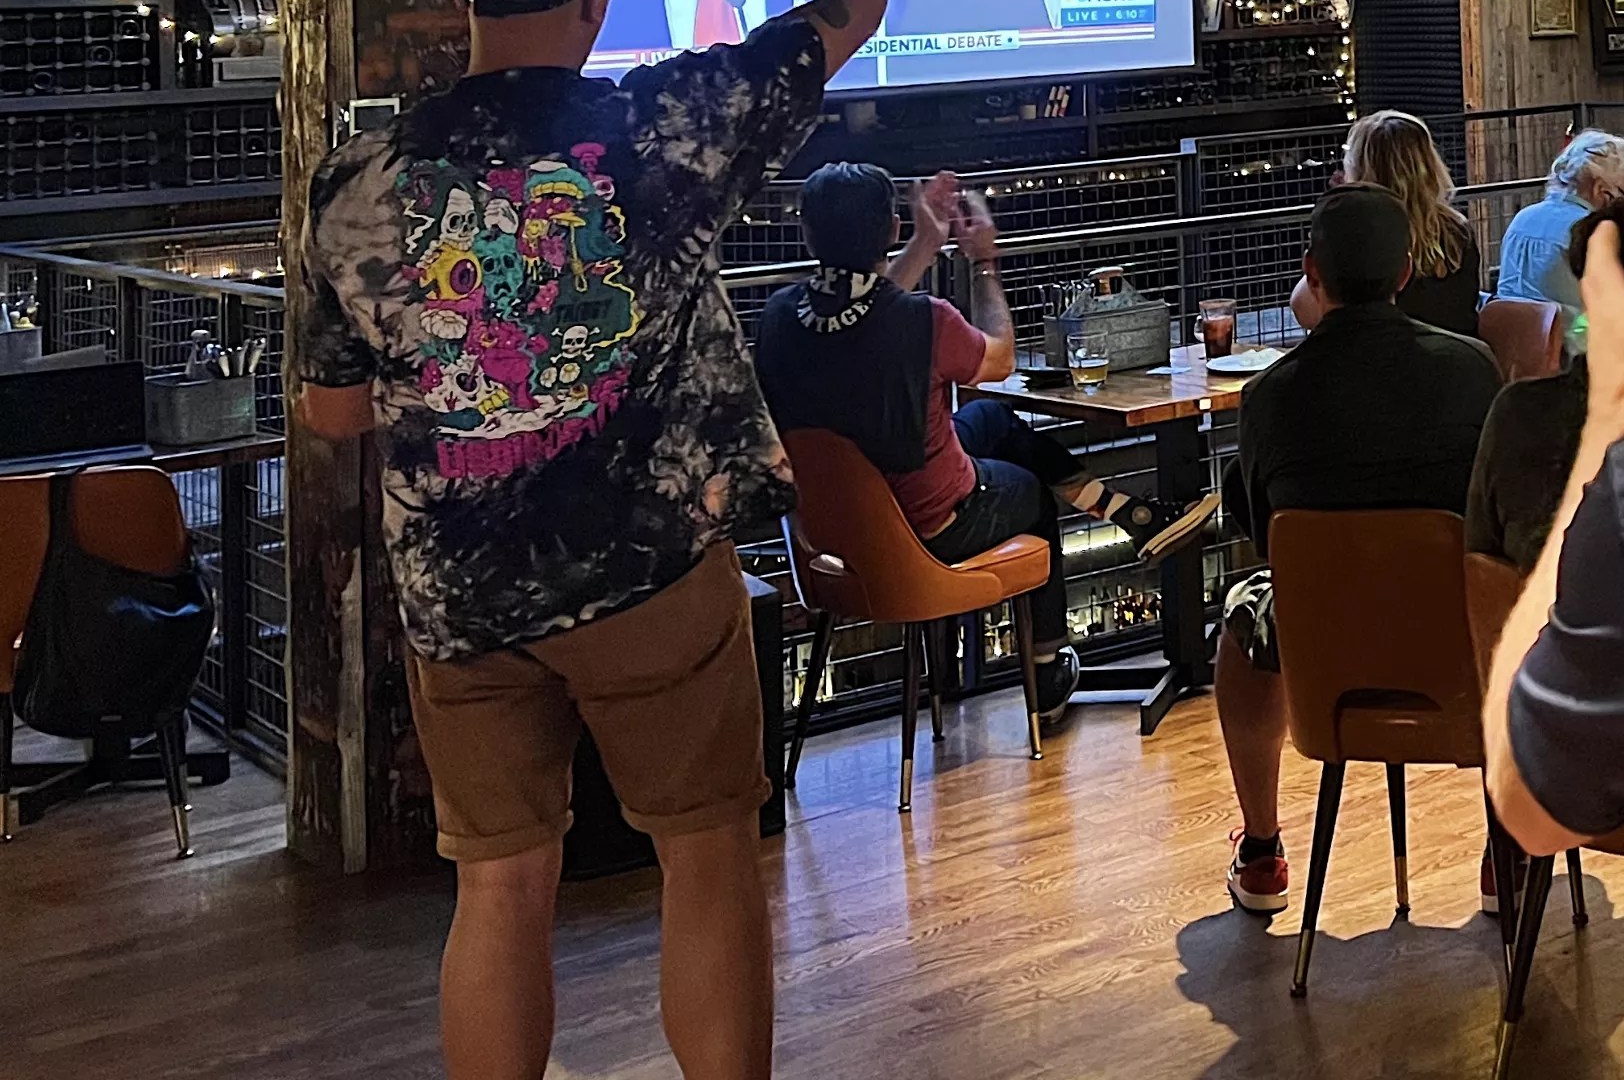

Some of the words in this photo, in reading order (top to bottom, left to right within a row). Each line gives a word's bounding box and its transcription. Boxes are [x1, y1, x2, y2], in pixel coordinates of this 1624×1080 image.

[1067, 11, 1098, 22] LIVE
[858, 37, 941, 54] SIDENTIAL
[947, 34, 1003, 49] DEBATE
